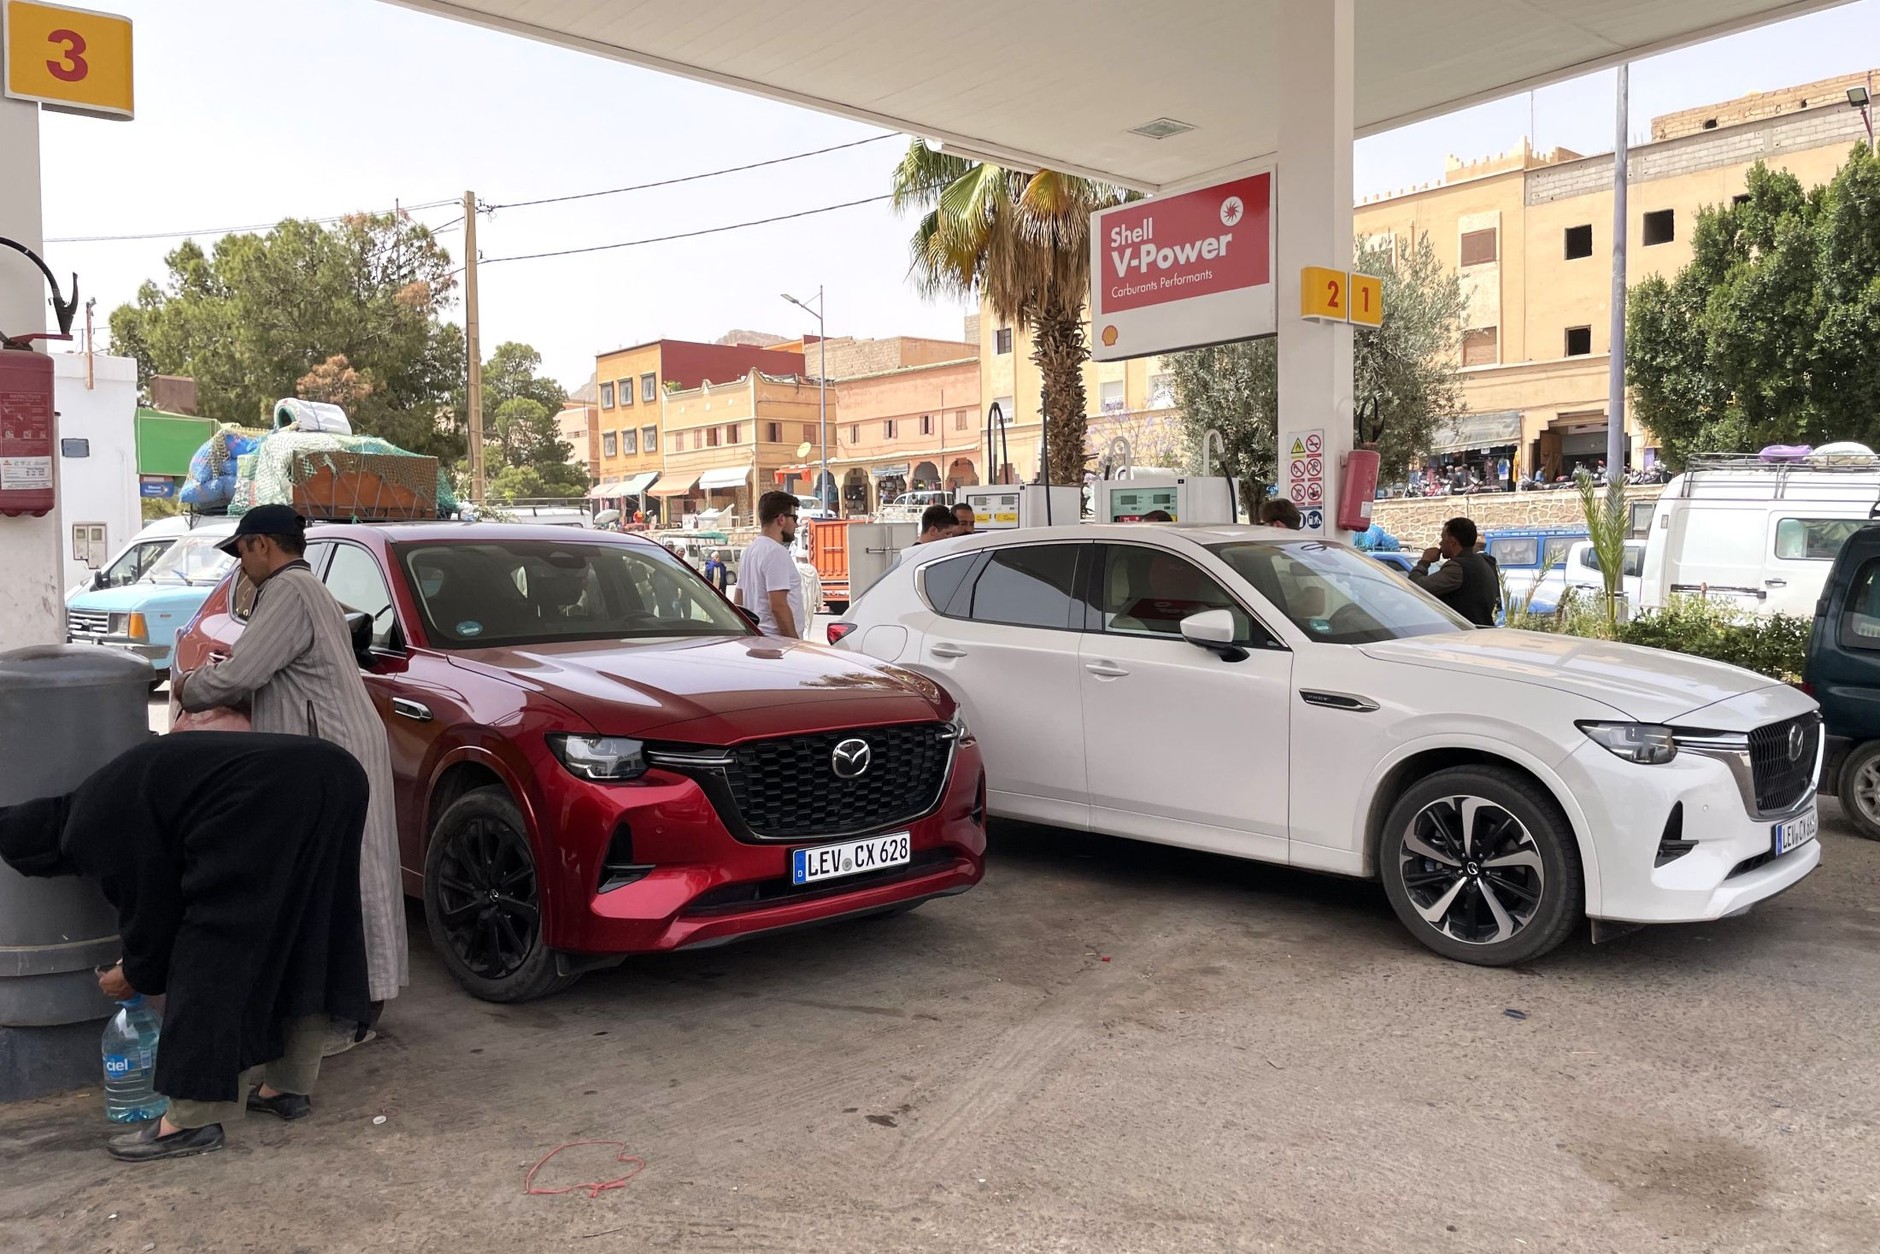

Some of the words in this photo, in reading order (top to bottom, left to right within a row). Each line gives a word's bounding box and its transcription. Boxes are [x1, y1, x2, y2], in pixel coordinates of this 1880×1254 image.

[46, 29, 89, 82] 3
[1110, 217, 1153, 248] Shell
[1111, 233, 1233, 278] V-Power
[1111, 281, 1159, 298] Carburants
[1160, 270, 1213, 288] Performants
[1327, 280, 1339, 308] 2
[1361, 286, 1369, 312] 1
[1782, 823, 1797, 849] LEV
[807, 848, 842, 877] LEV
[855, 842, 876, 868] CX
[880, 837, 908, 863] 628
[797, 870, 803, 878] D
